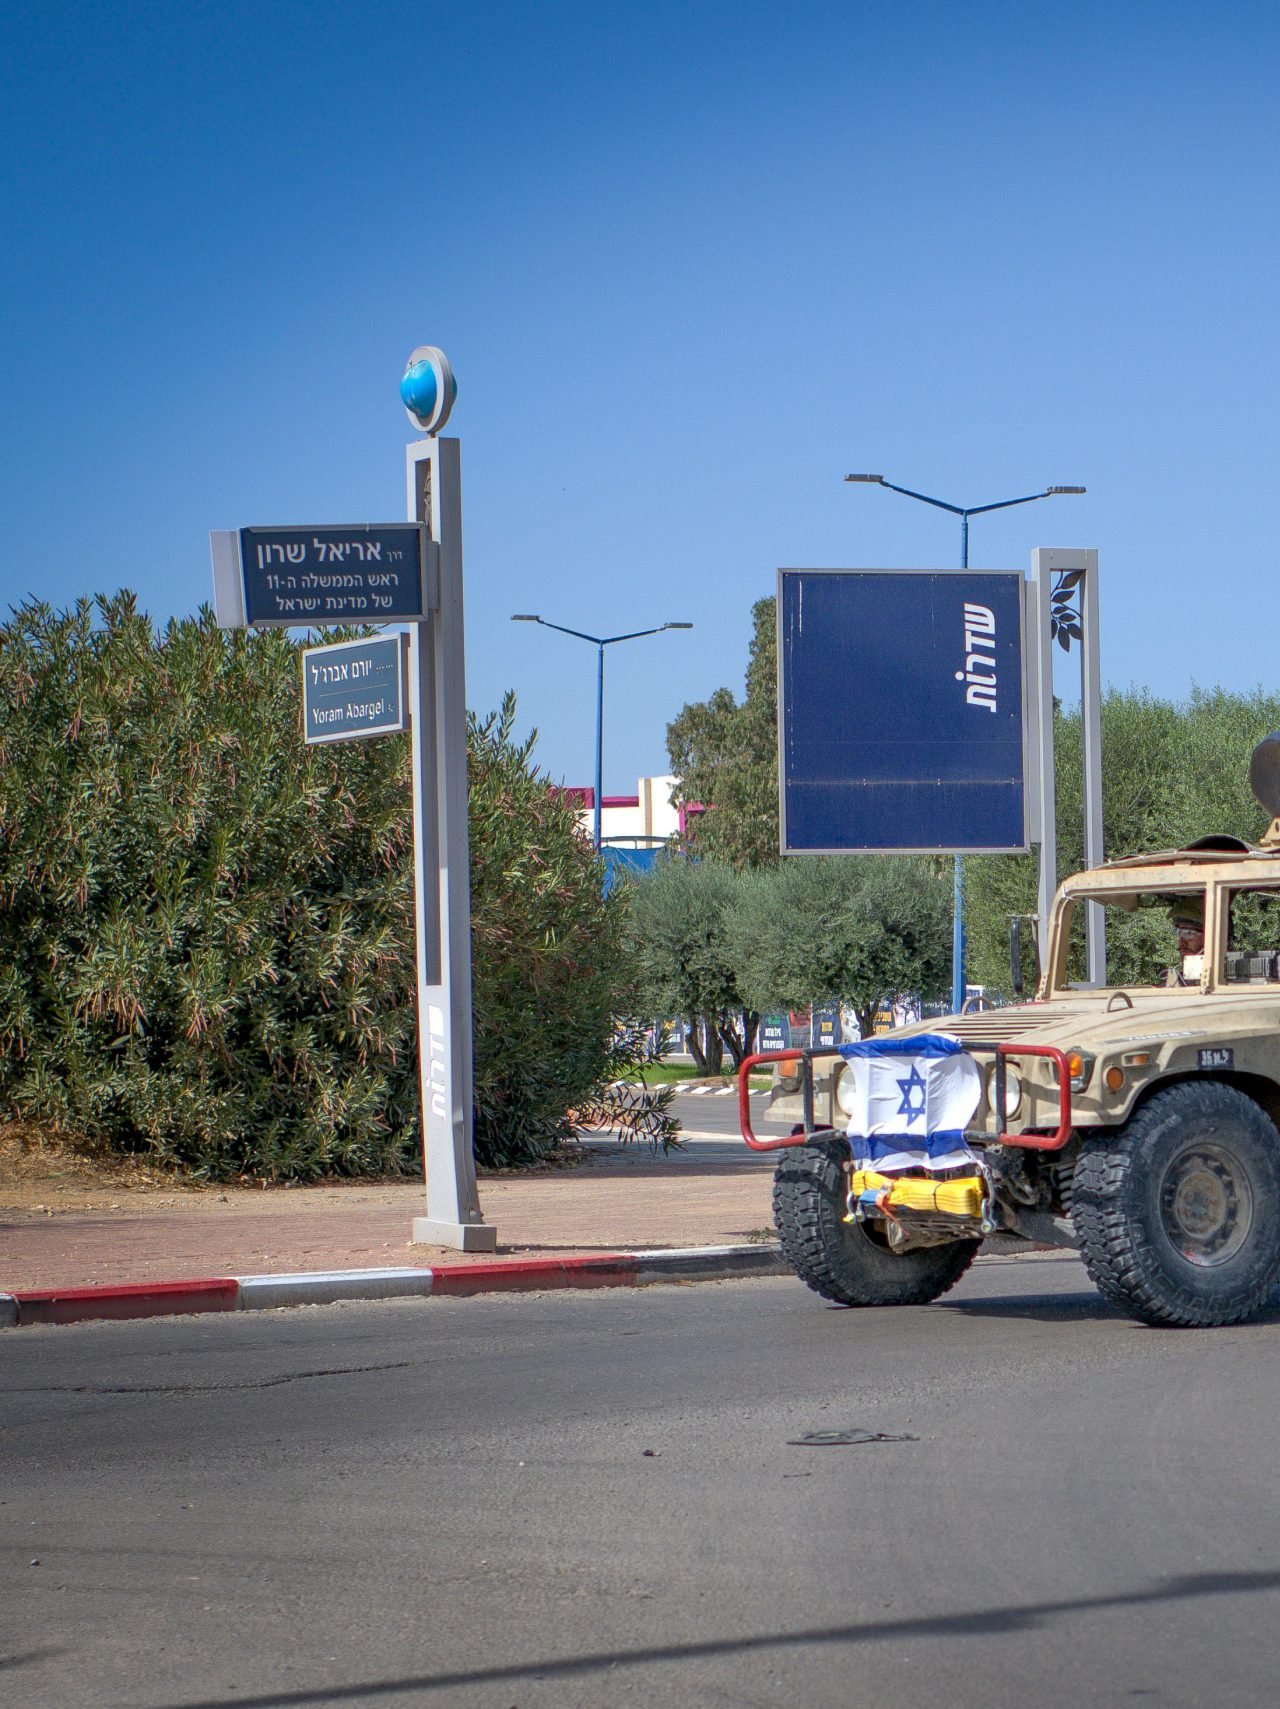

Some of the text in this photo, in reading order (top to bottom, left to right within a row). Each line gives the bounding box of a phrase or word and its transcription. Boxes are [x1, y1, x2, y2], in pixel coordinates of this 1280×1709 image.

[257, 544, 306, 569] שרון
[313, 538, 382, 562] אריאל
[302, 572, 363, 588] הממשלה
[368, 574, 399, 587] ראש
[276, 593, 393, 611] של מדינת ישראל
[352, 660, 372, 678] יורם
[312, 708, 343, 724] Yoram
[346, 697, 385, 720] Abargel
